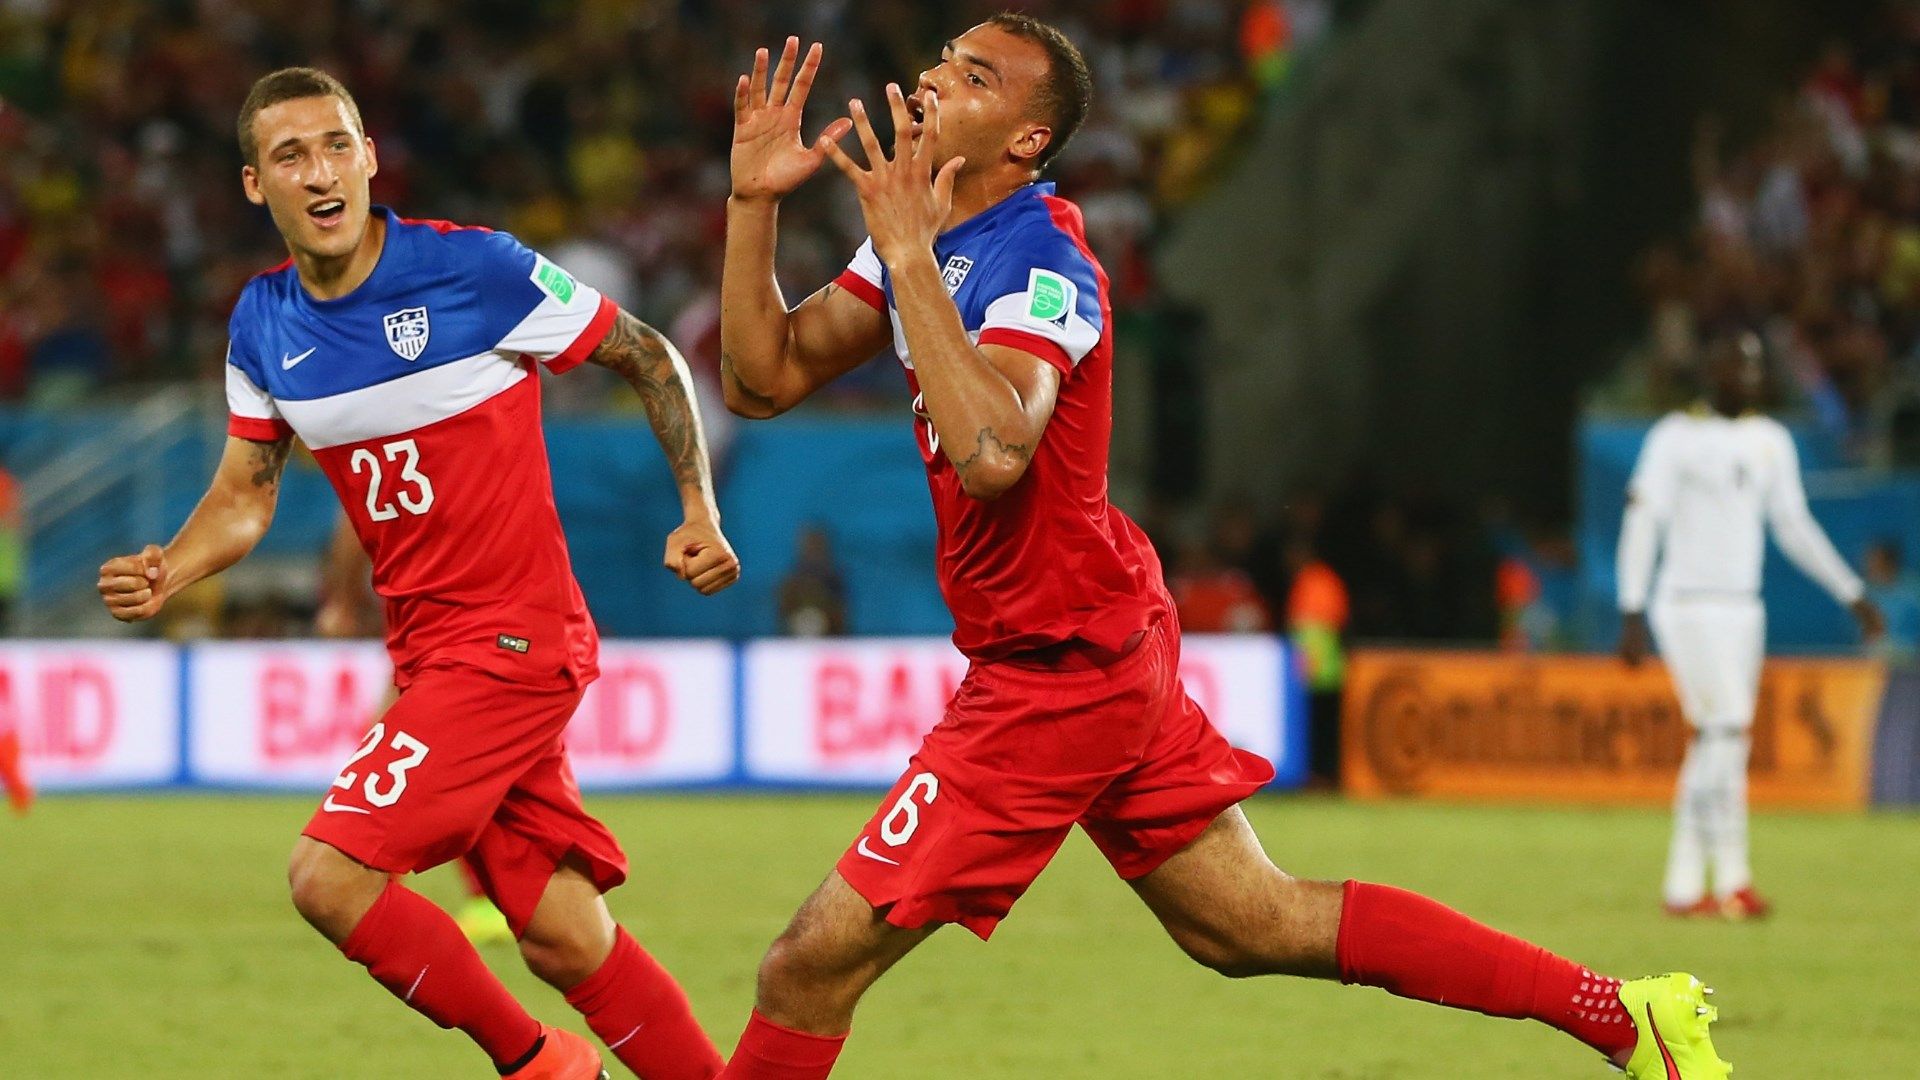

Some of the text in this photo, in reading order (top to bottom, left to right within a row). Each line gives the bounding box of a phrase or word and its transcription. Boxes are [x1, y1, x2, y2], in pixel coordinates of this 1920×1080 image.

[350, 438, 435, 522] 23
[332, 722, 430, 808] 23
[880, 771, 940, 847] 6
